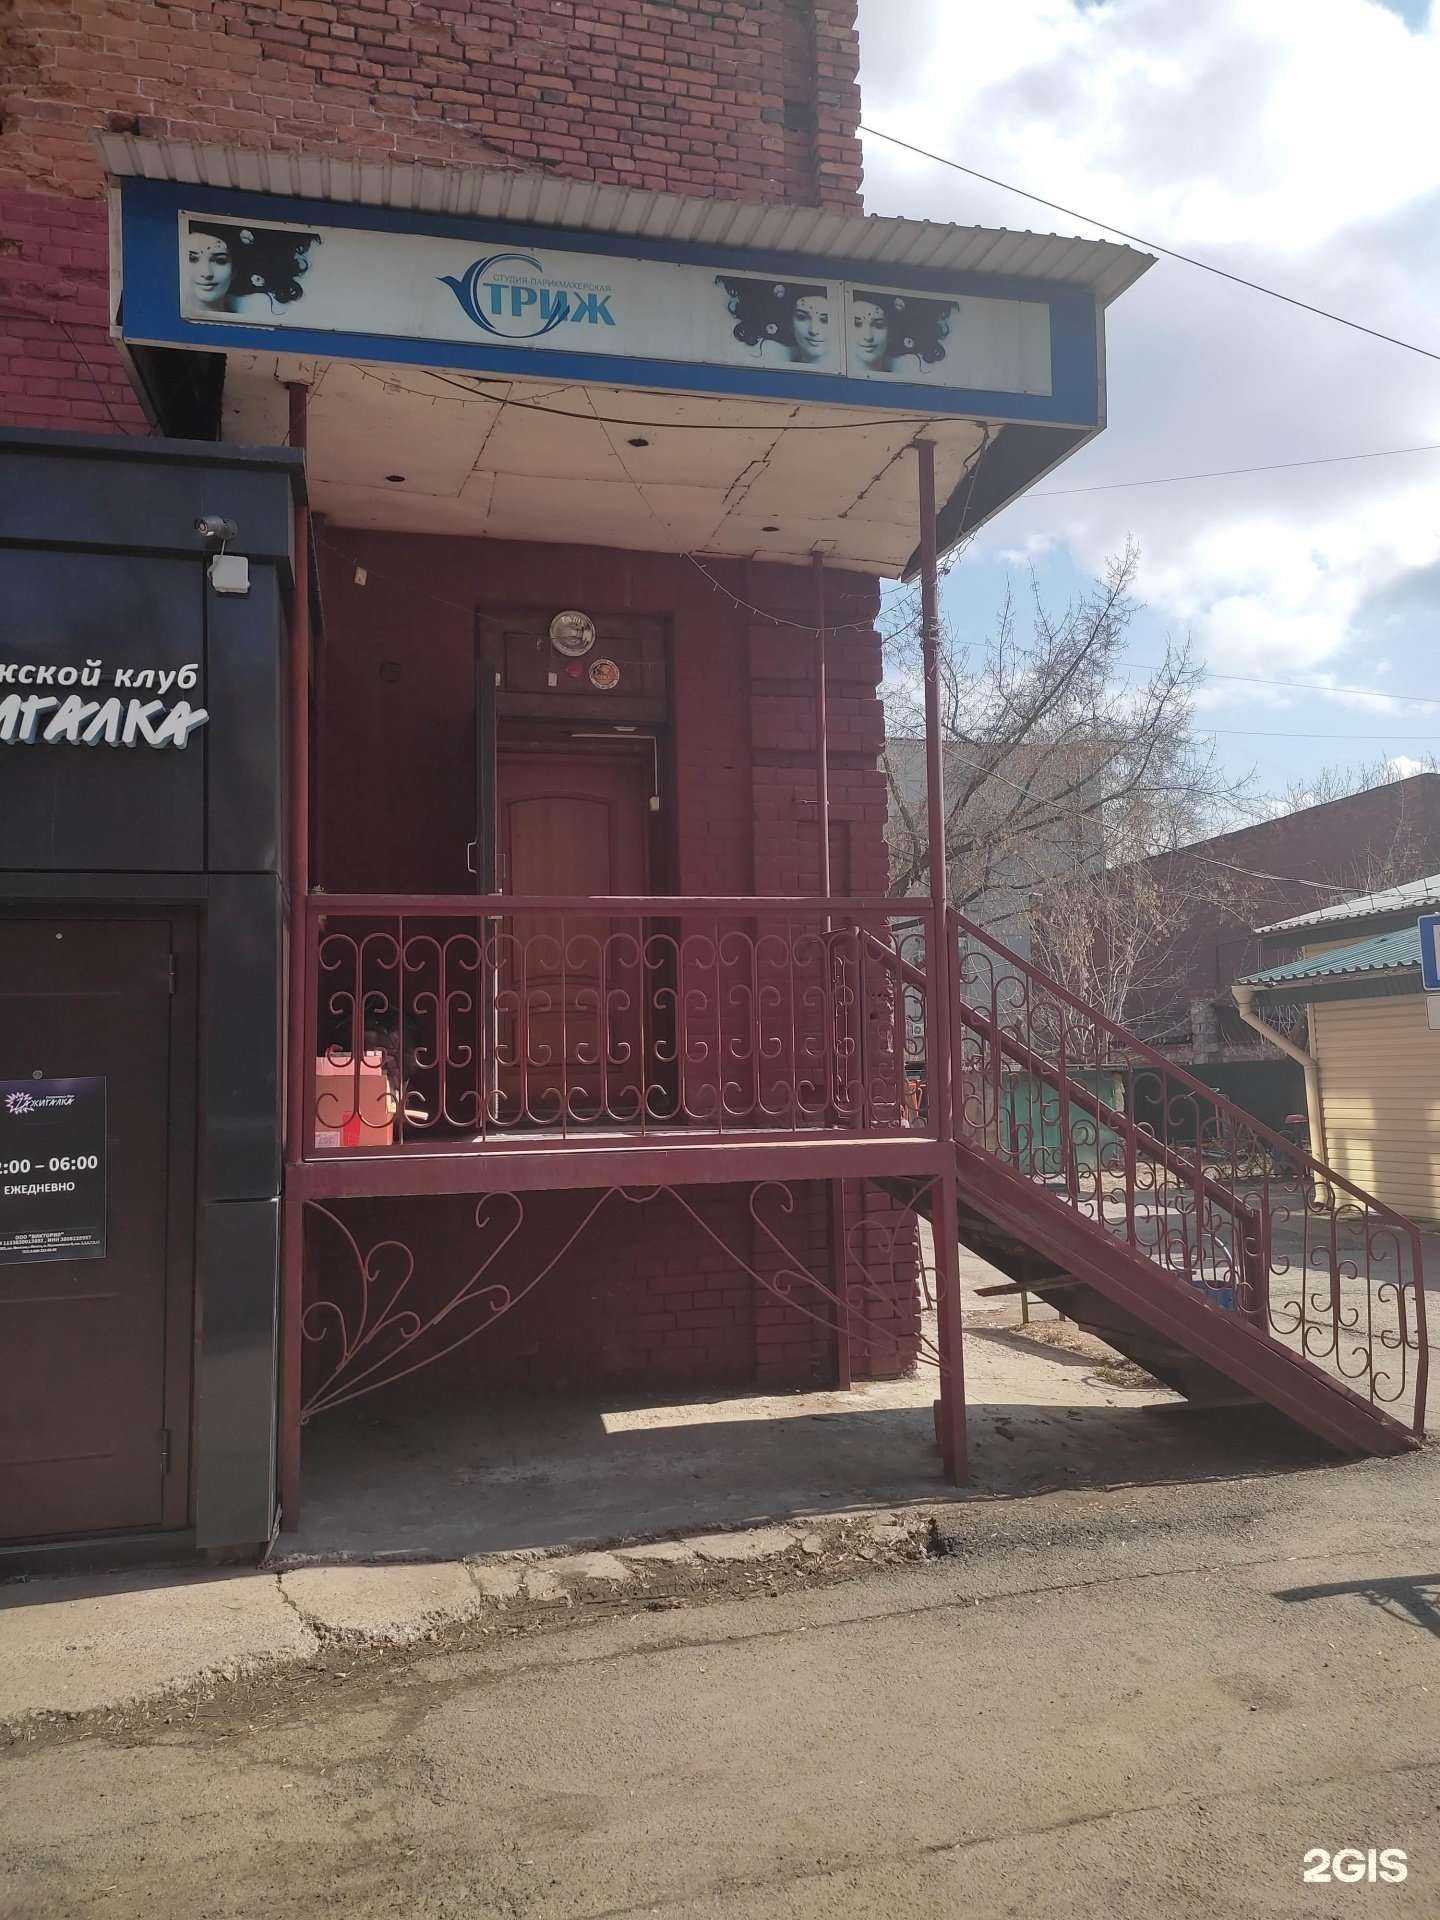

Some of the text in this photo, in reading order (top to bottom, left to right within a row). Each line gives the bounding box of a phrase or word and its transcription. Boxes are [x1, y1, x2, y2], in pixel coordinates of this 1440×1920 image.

[114, 663, 199, 695] клуб
[0, 1159, 31, 1175] :00
[49, 1155, 98, 1172] 06:00
[4, 1181, 75, 1195] ЕЖЕДНЕВНО
